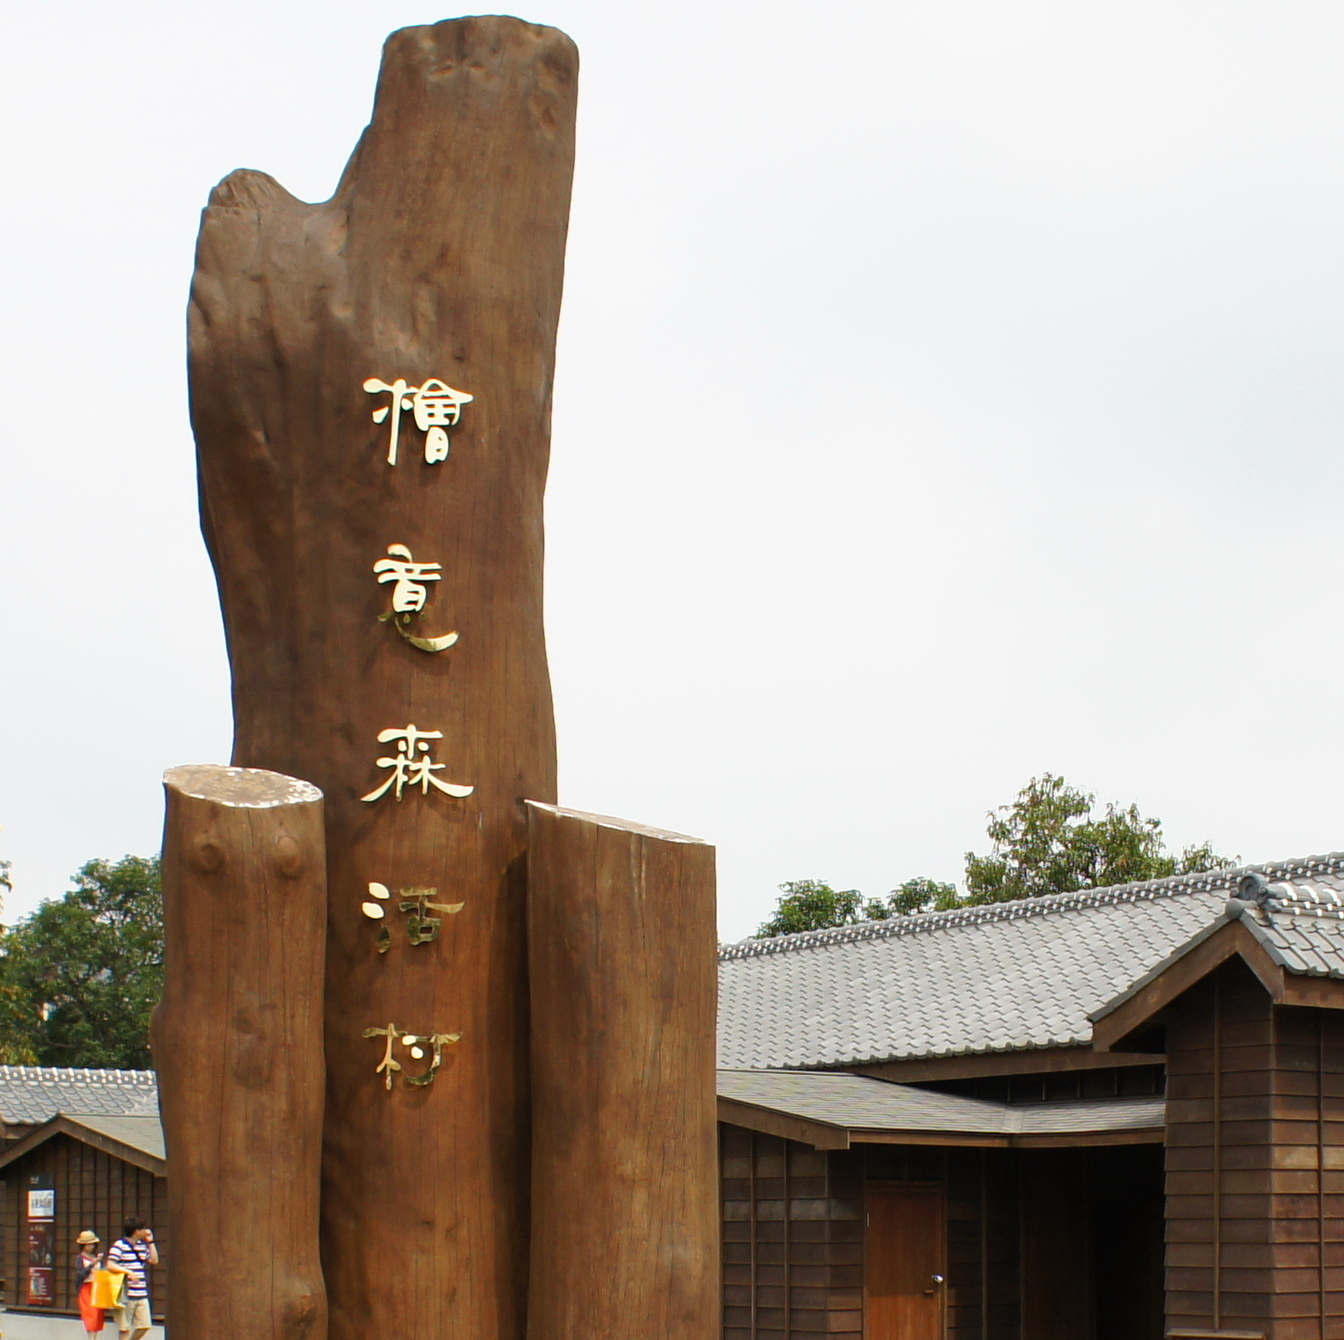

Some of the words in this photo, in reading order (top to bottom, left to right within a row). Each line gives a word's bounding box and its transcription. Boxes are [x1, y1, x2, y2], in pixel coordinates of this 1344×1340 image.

[361, 377, 475, 1091] 檜意森活村
